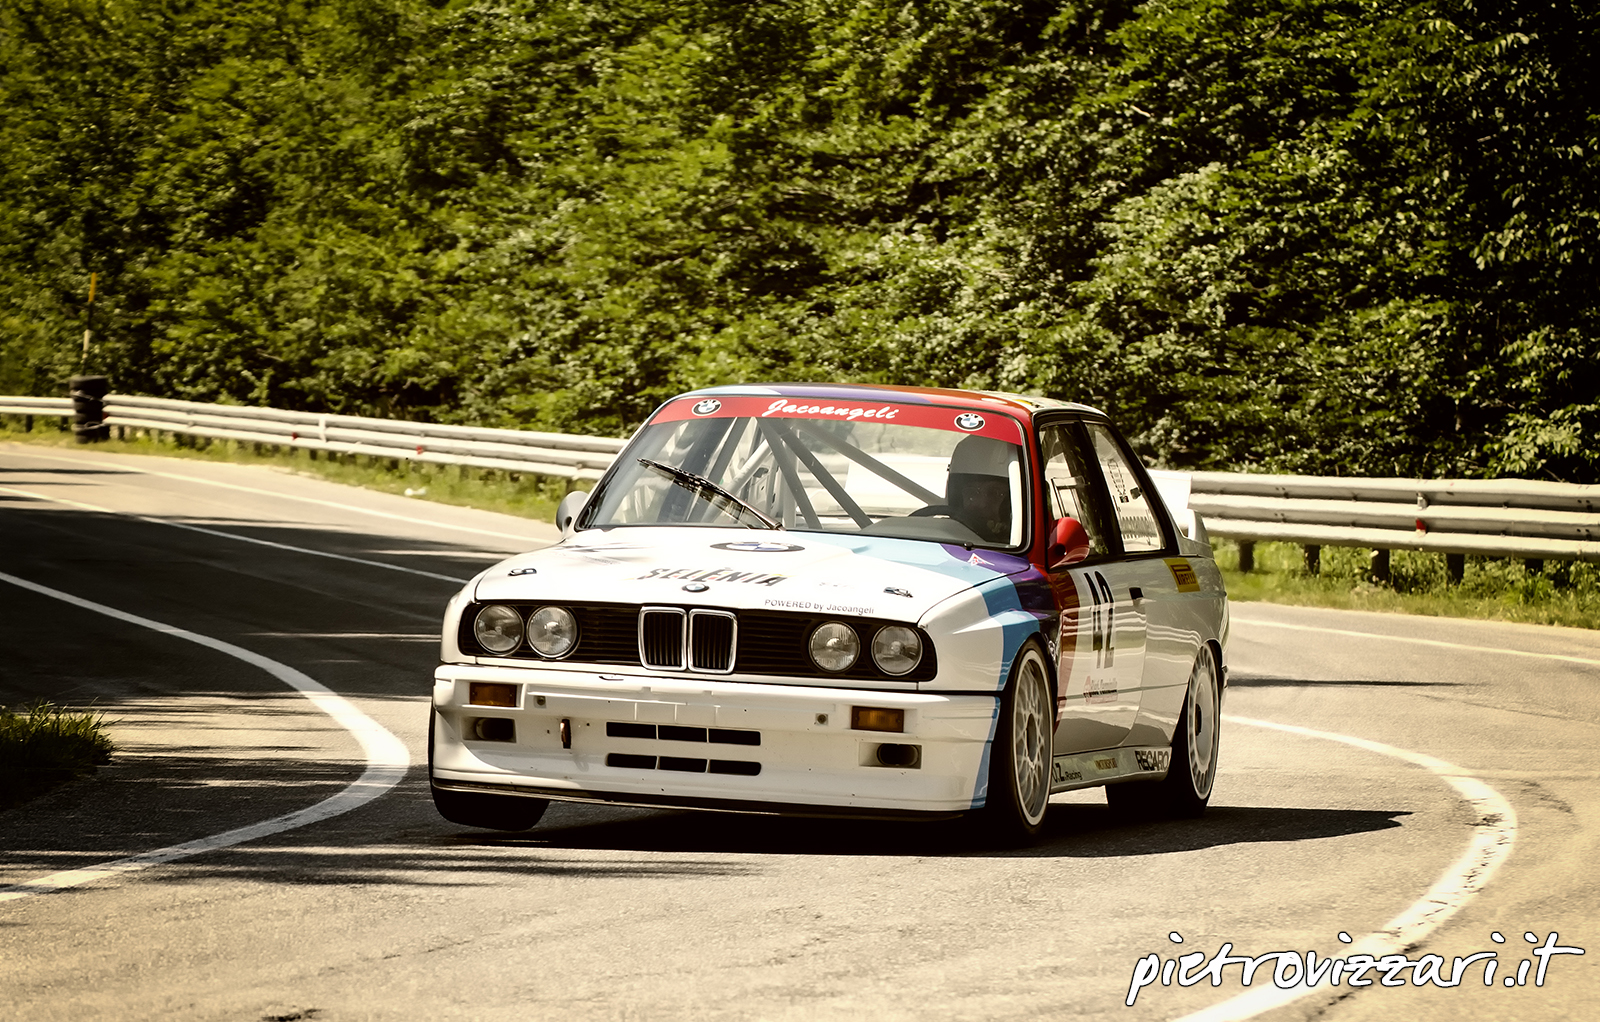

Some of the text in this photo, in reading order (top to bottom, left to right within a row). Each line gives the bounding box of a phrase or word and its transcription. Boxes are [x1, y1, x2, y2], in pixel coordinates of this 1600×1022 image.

[761, 399, 899, 421] Jacoangeli
[764, 599, 874, 616] POWERED by Jacoangeli
[1083, 571, 1115, 669] 42
[1134, 750, 1169, 772] RECARO
